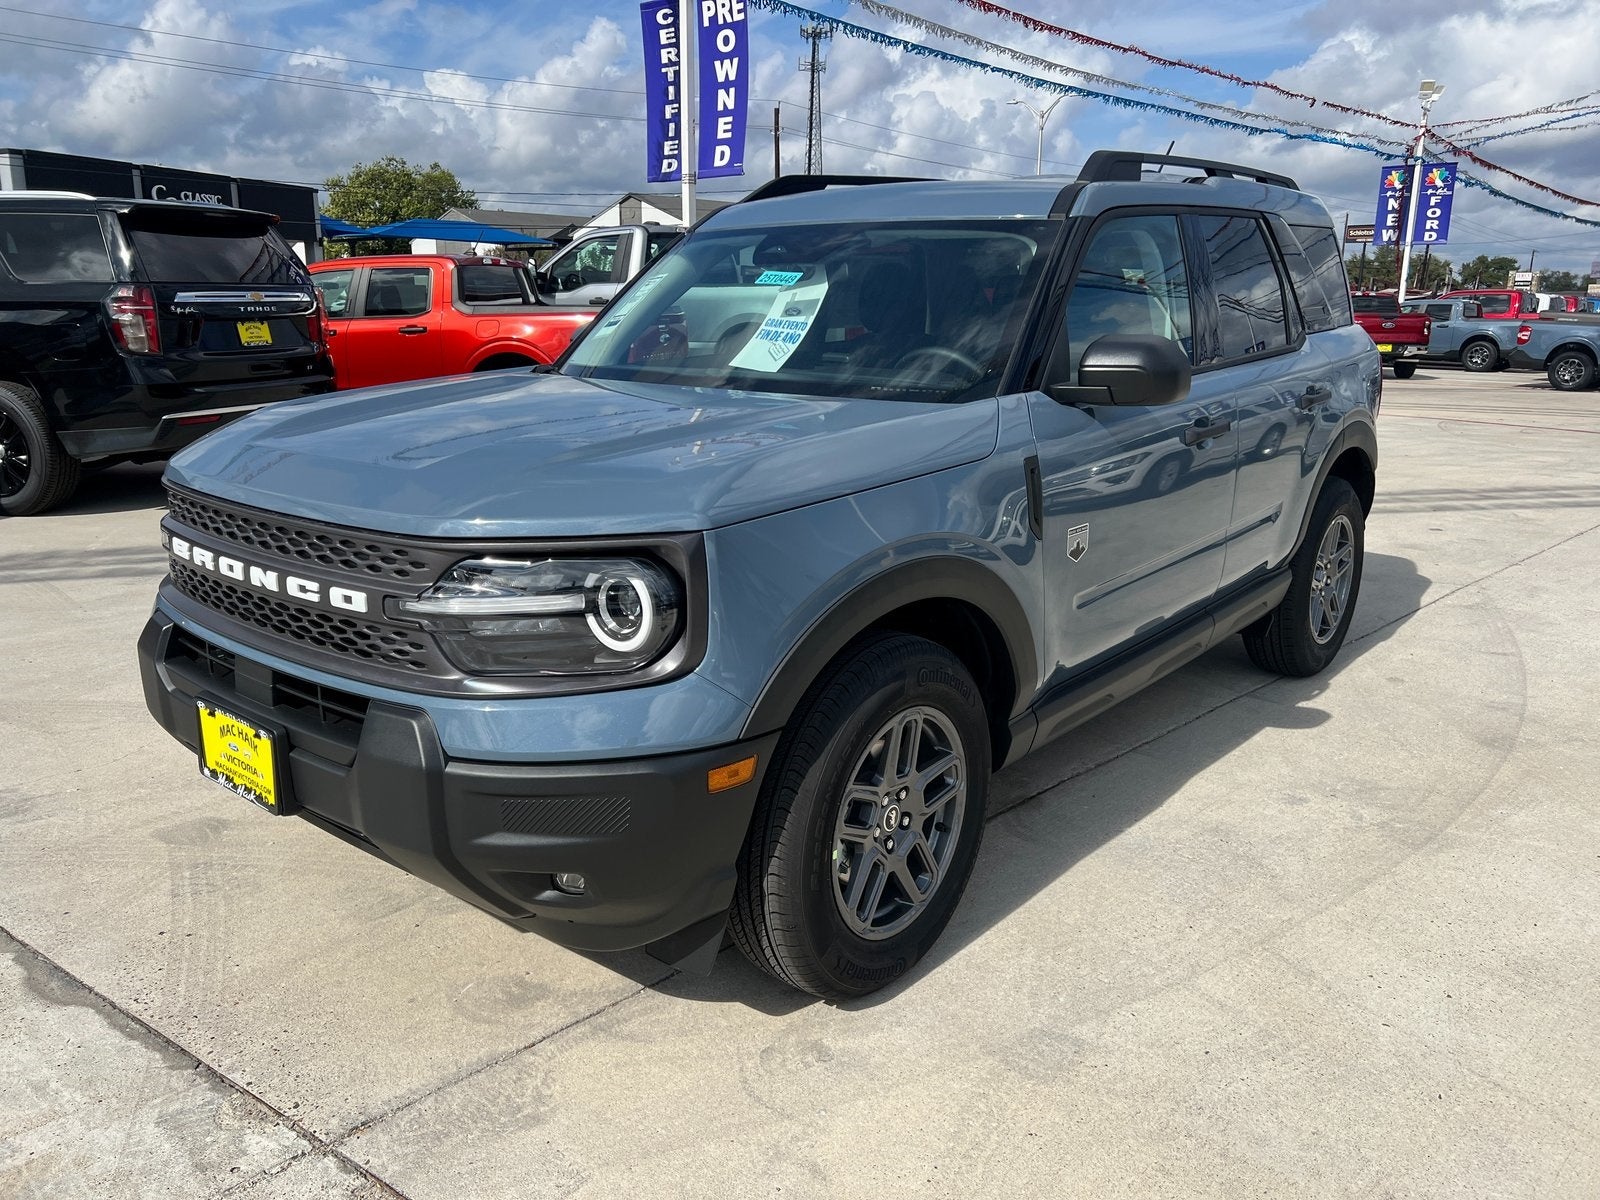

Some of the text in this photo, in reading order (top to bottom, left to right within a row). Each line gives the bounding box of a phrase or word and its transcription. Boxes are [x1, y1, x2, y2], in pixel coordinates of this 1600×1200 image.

[702, 0, 745, 27] PRE
[655, 8, 680, 174] CERTIFIED
[713, 28, 739, 168] OWNED
[180, 191, 223, 205] CLASSIC
[1381, 197, 1401, 242] NEW
[1423, 195, 1442, 242] FORD
[760, 273, 798, 285] 25T0449
[755, 328, 770, 340] FIN
[770, 330, 784, 342] DE
[764, 317, 808, 332] GRAN EVENTO
[171, 535, 369, 613] BRONCO
[918, 666, 971, 700] Continental
[219, 724, 259, 756] MAC HAIK
[225, 752, 258, 778] VICTORIA
